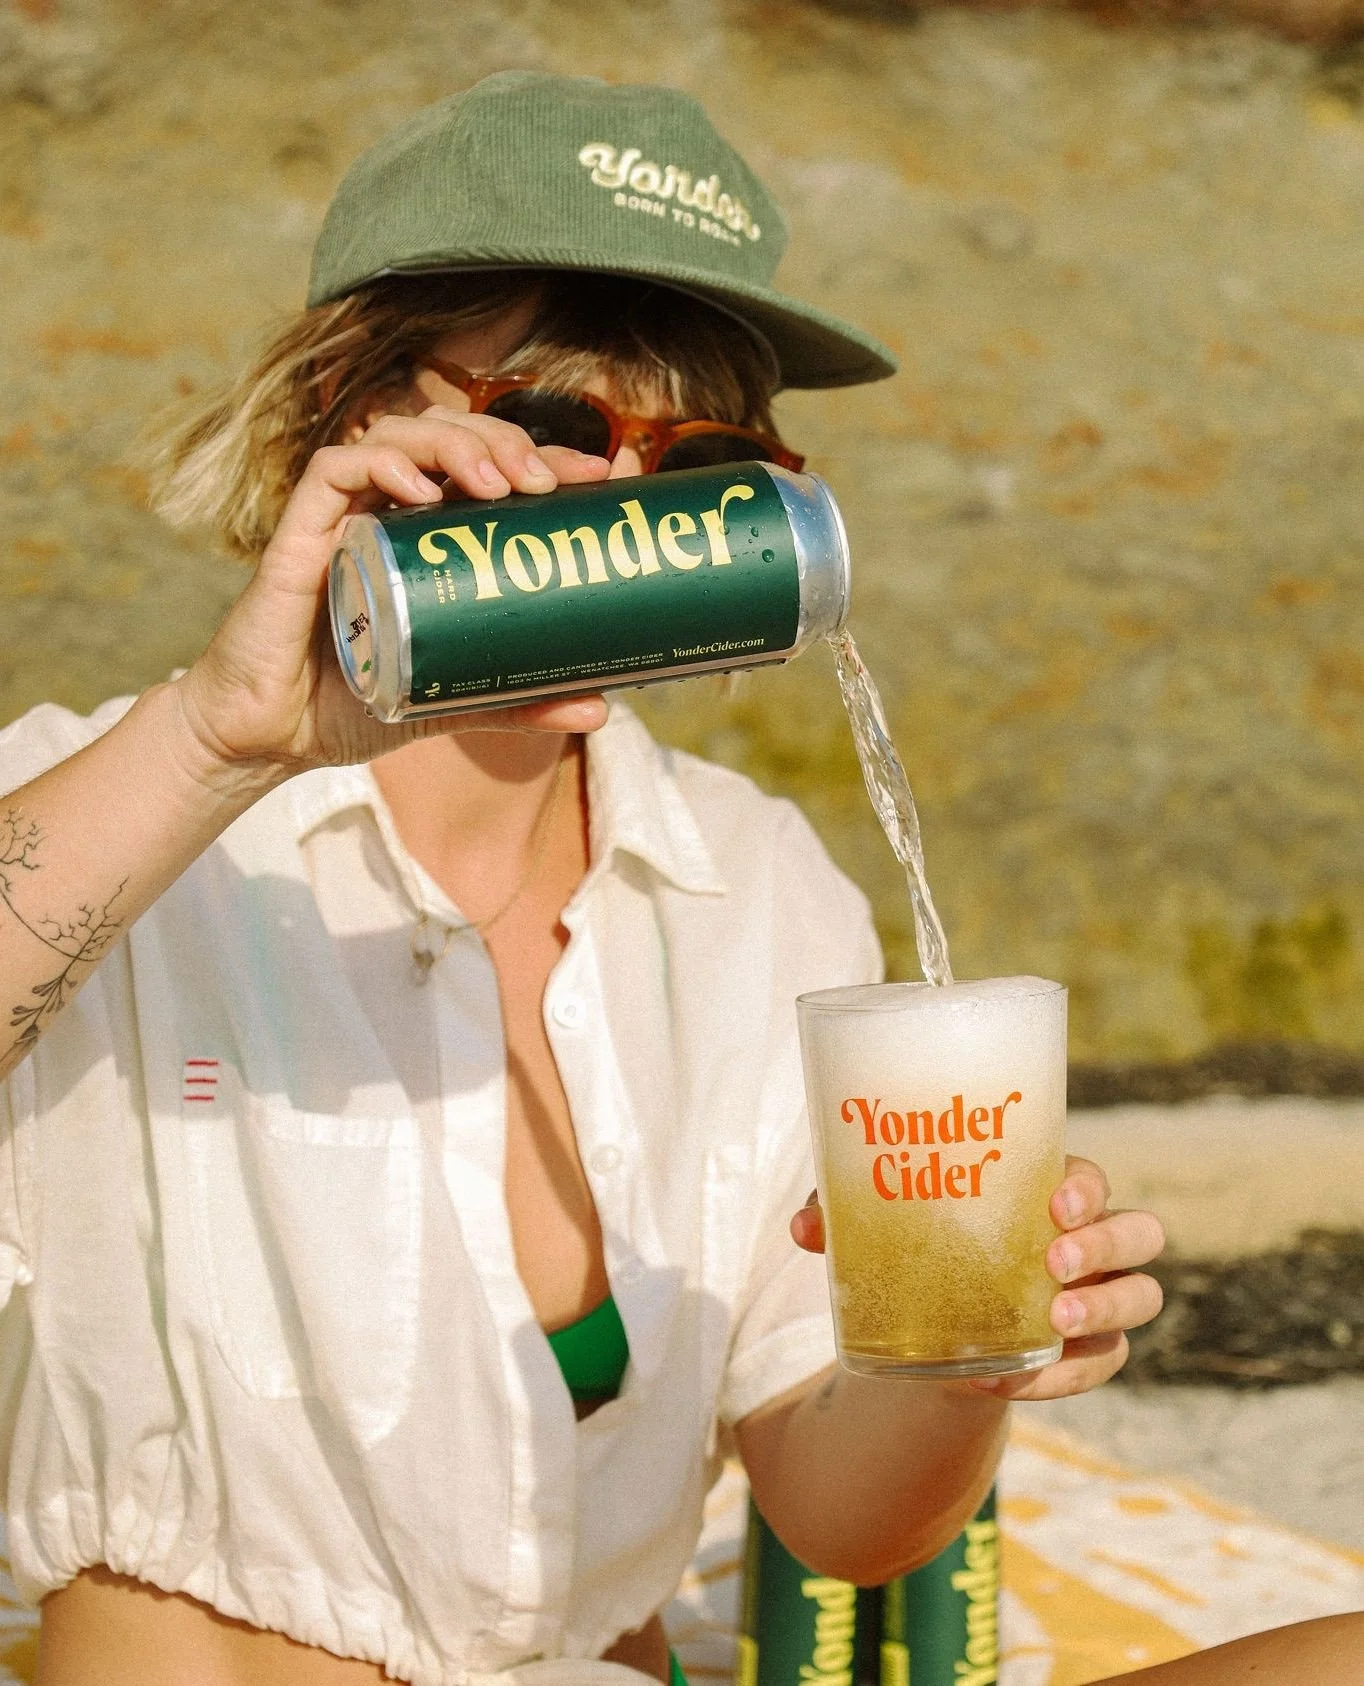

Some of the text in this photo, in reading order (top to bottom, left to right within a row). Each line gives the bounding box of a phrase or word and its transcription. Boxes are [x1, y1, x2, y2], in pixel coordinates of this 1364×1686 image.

[579, 142, 761, 241] Yonder
[614, 192, 666, 218] BORN
[672, 208, 695, 228] TO
[418, 484, 754, 600] Yonder
[433, 569, 446, 604] CIDER
[445, 569, 456, 601] HARD
[672, 638, 765, 658] YonderCider.com
[467, 678, 491, 686] CLASS
[507, 670, 548, 680] PRODUCED
[566, 662, 596, 671] CANNED
[611, 656, 640, 664] YONDER
[641, 652, 664, 660] CIDER
[533, 673, 560, 681] MILLER
[840, 1091, 1022, 1145] Yonder
[872, 1149, 1001, 1201] Cider
